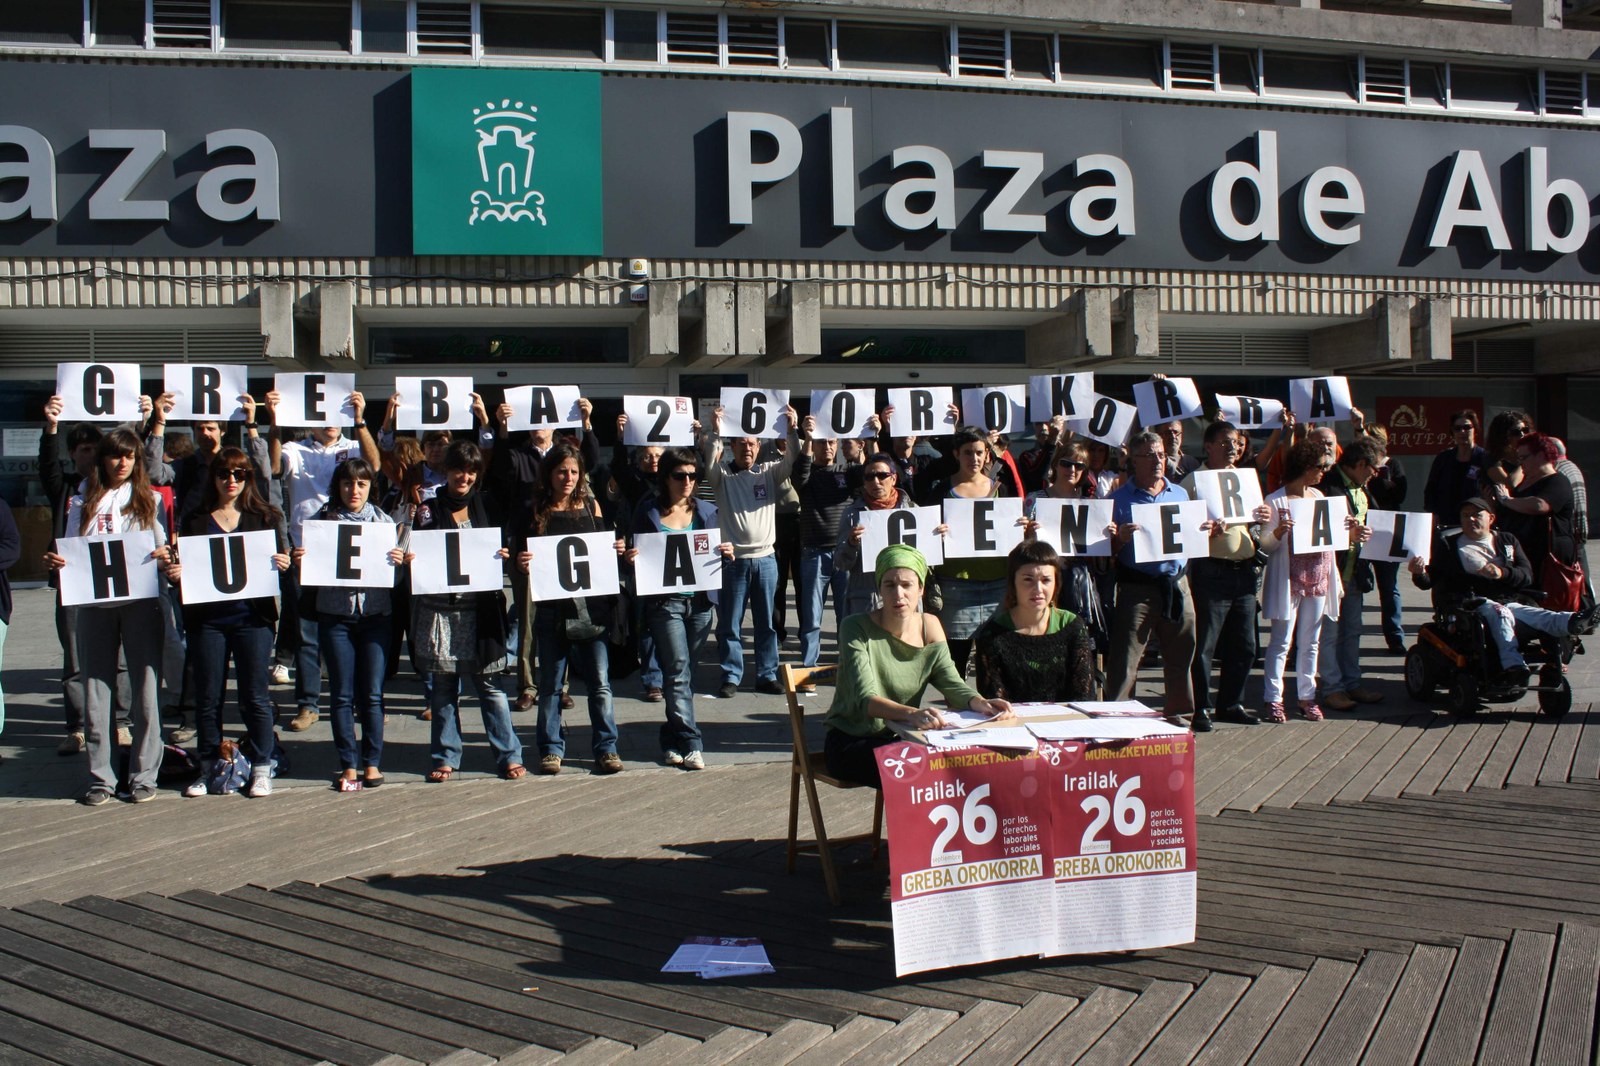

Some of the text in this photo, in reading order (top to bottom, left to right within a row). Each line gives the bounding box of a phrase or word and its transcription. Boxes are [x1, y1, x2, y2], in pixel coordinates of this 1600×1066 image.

[727, 106, 1590, 254] Plaza de Ab
[83, 364, 115, 416] G
[192, 366, 221, 415] R
[304, 374, 326, 421] E
[421, 379, 449, 425] B
[530, 387, 559, 425] A
[910, 390, 934, 431] R
[1051, 375, 1076, 417] K
[1153, 378, 1182, 419] R
[1236, 396, 1263, 425] R
[1310, 378, 1336, 418] A
[647, 399, 671, 442] 2
[741, 391, 767, 435] 6
[831, 391, 856, 434] O
[984, 391, 1008, 434] O
[1088, 398, 1117, 437] O
[1217, 471, 1245, 518] R
[974, 500, 996, 551] E
[1060, 504, 1089, 554] N
[1160, 504, 1183, 555] E
[1311, 499, 1333, 547] A
[1388, 514, 1410, 558] L
[209, 535, 248, 594] U
[336, 524, 362, 580] E
[445, 532, 470, 587] L
[556, 536, 591, 592] G
[662, 533, 697, 587] A
[698, 540, 708, 551] 26
[88, 539, 130, 600] H
[1174, 742, 1188, 754] EZ
[911, 779, 967, 805] Irailak
[1064, 770, 1118, 792] Irailak
[928, 783, 998, 867] 26
[1003, 817, 1016, 826] por
[1003, 825, 1038, 835] derechos
[1080, 776, 1146, 855] 26
[1151, 808, 1175, 818] por los
[1151, 818, 1183, 827] derechos
[1151, 827, 1183, 837] laborales
[1004, 834, 1038, 844] laborales
[1004, 844, 1041, 855] y sociales
[1157, 836, 1185, 845] sociales
[904, 857, 1040, 893] GREBA OROKORRA
[1054, 850, 1183, 878] GREBA OROKORRA
